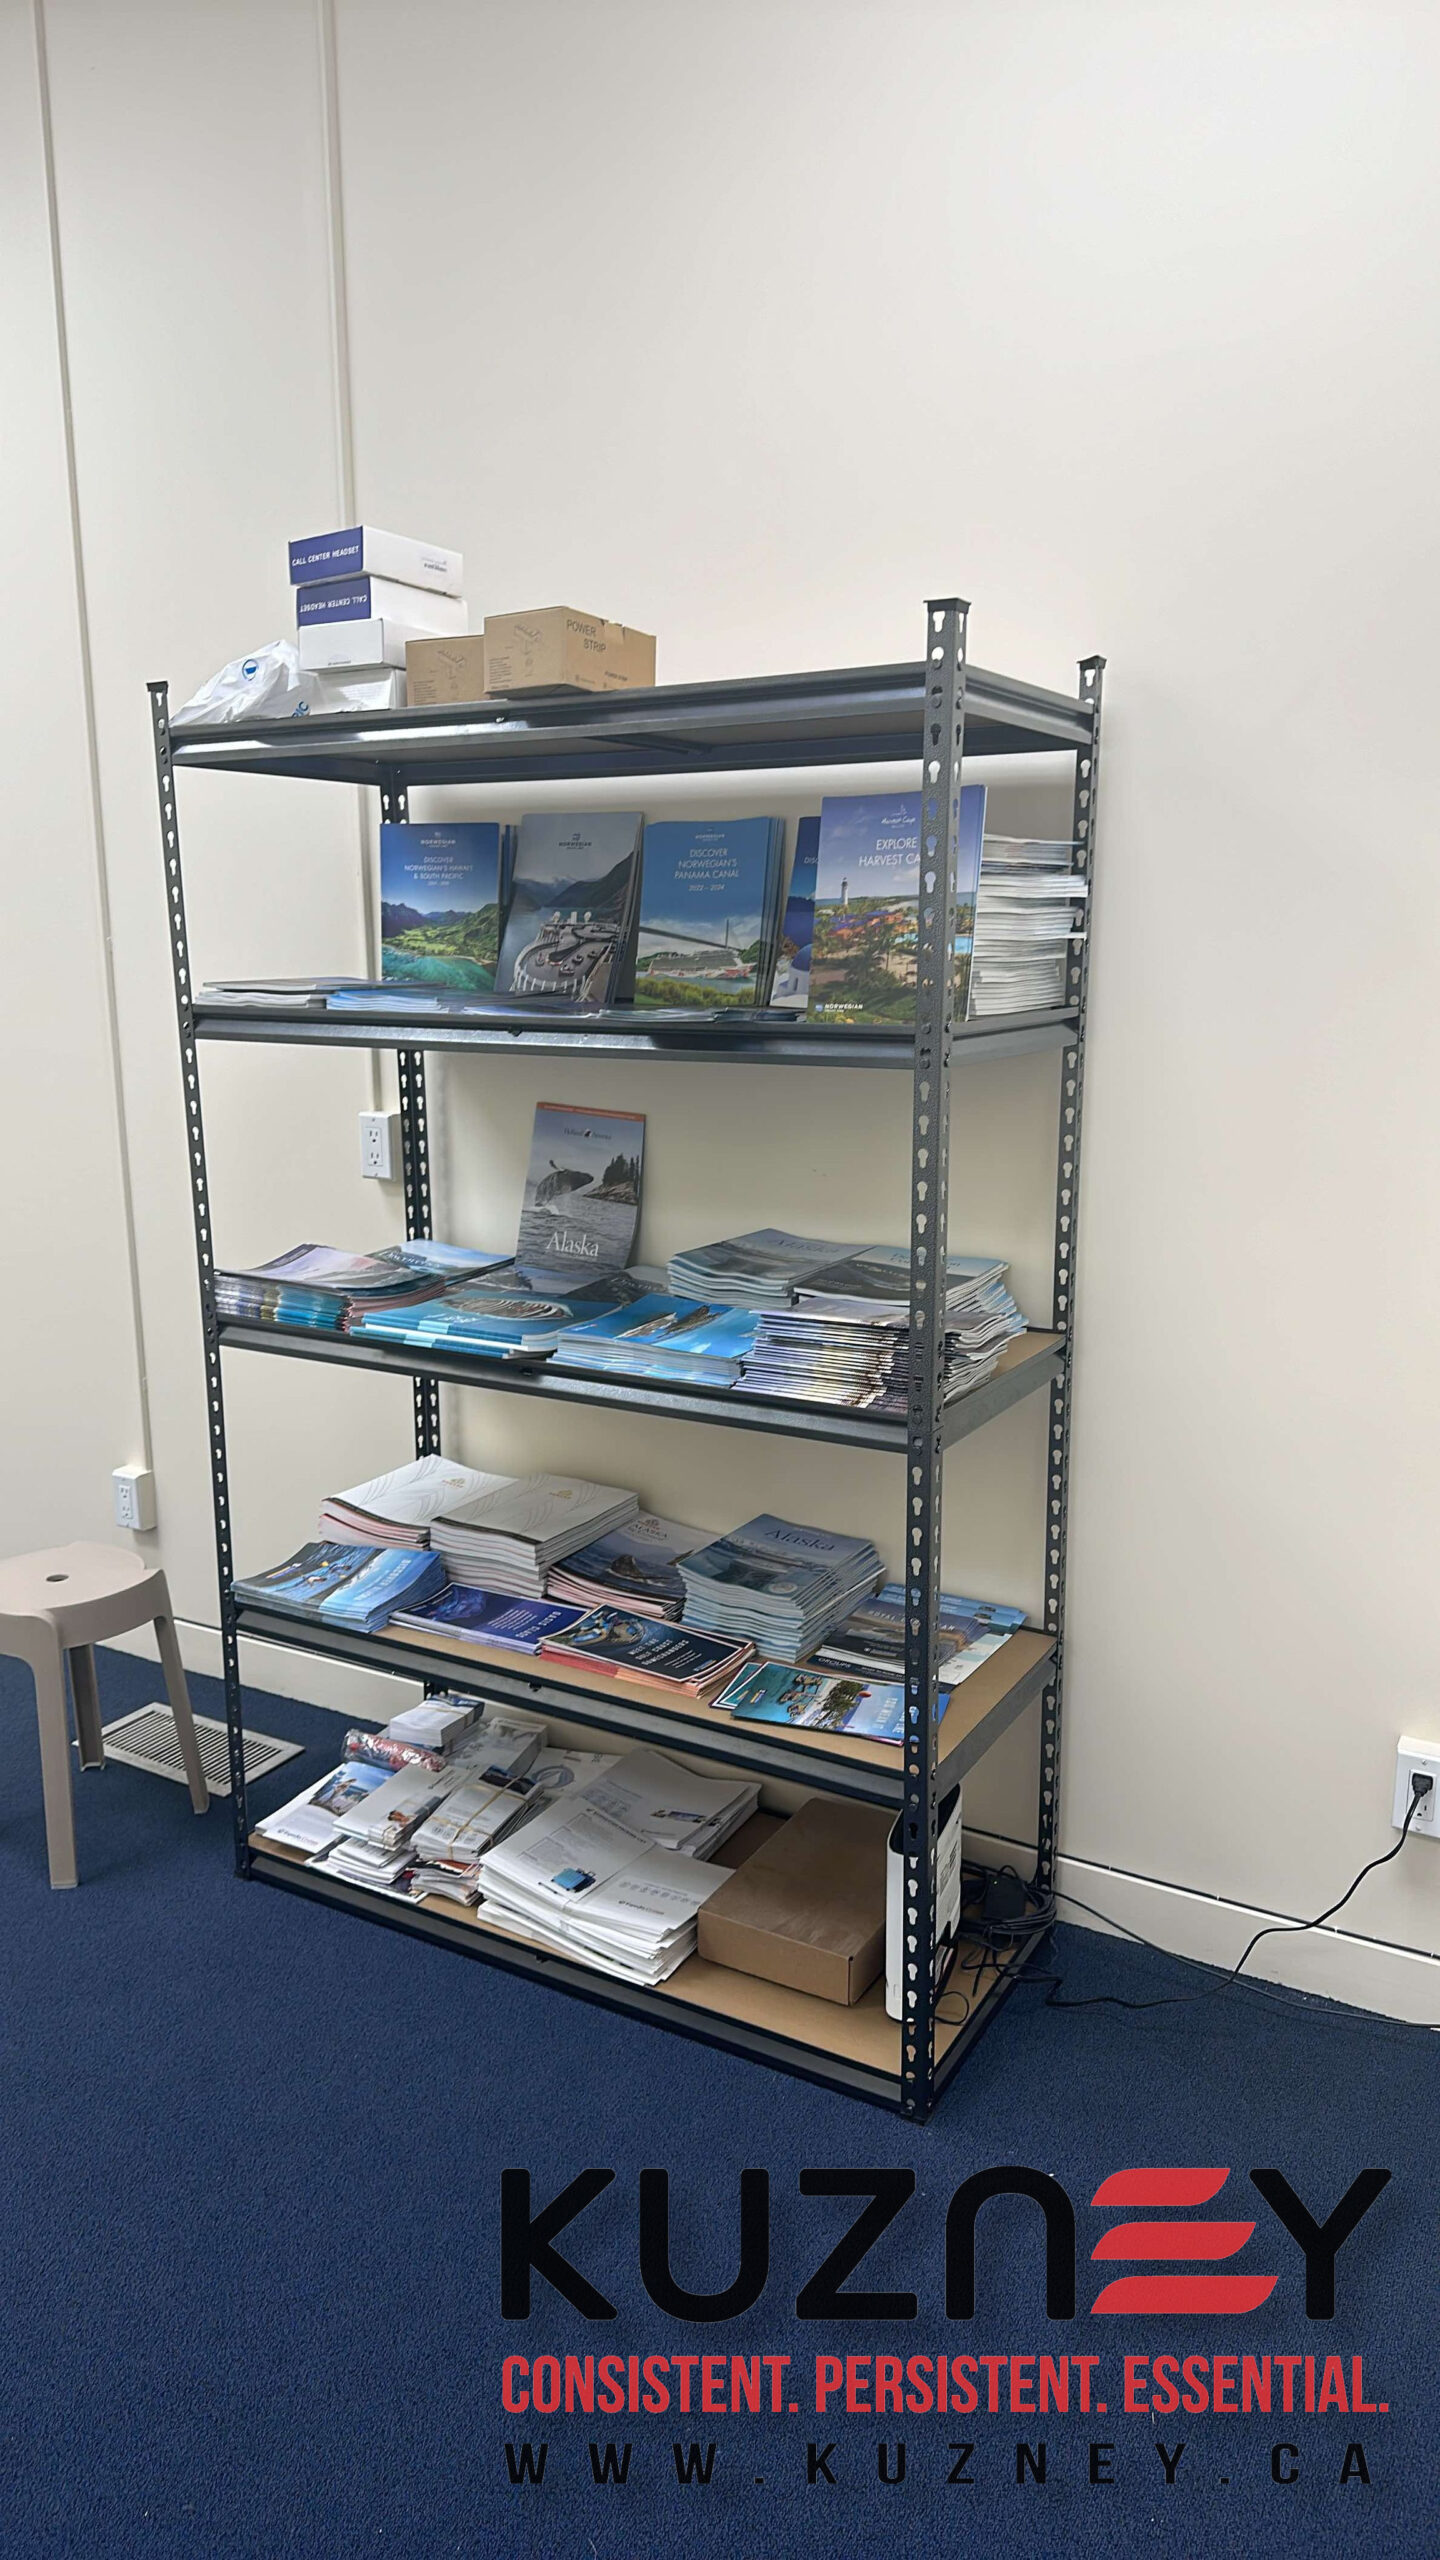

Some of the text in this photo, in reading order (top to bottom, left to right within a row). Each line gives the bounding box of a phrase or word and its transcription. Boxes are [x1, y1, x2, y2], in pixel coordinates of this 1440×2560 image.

[292, 545, 359, 567] CALL CENTER HEADSET
[300, 594, 367, 613] CALL CENTER HEADSET
[566, 619, 596, 638] POWER
[584, 638, 606, 652] STRIP
[876, 836, 918, 850] EXPLORE
[423, 856, 453, 864] DISCOVER
[689, 848, 729, 858] DISCOVER
[858, 852, 921, 867] HARVEST CA
[678, 858, 738, 870] NORWEGIAN'S
[420, 872, 440, 880] SOUTH
[440, 872, 464, 880] PACIFIC
[674, 869, 740, 880] PANAMA CANAL
[546, 1231, 600, 1257] Alaska
[764, 1529, 836, 1551] Alaska
